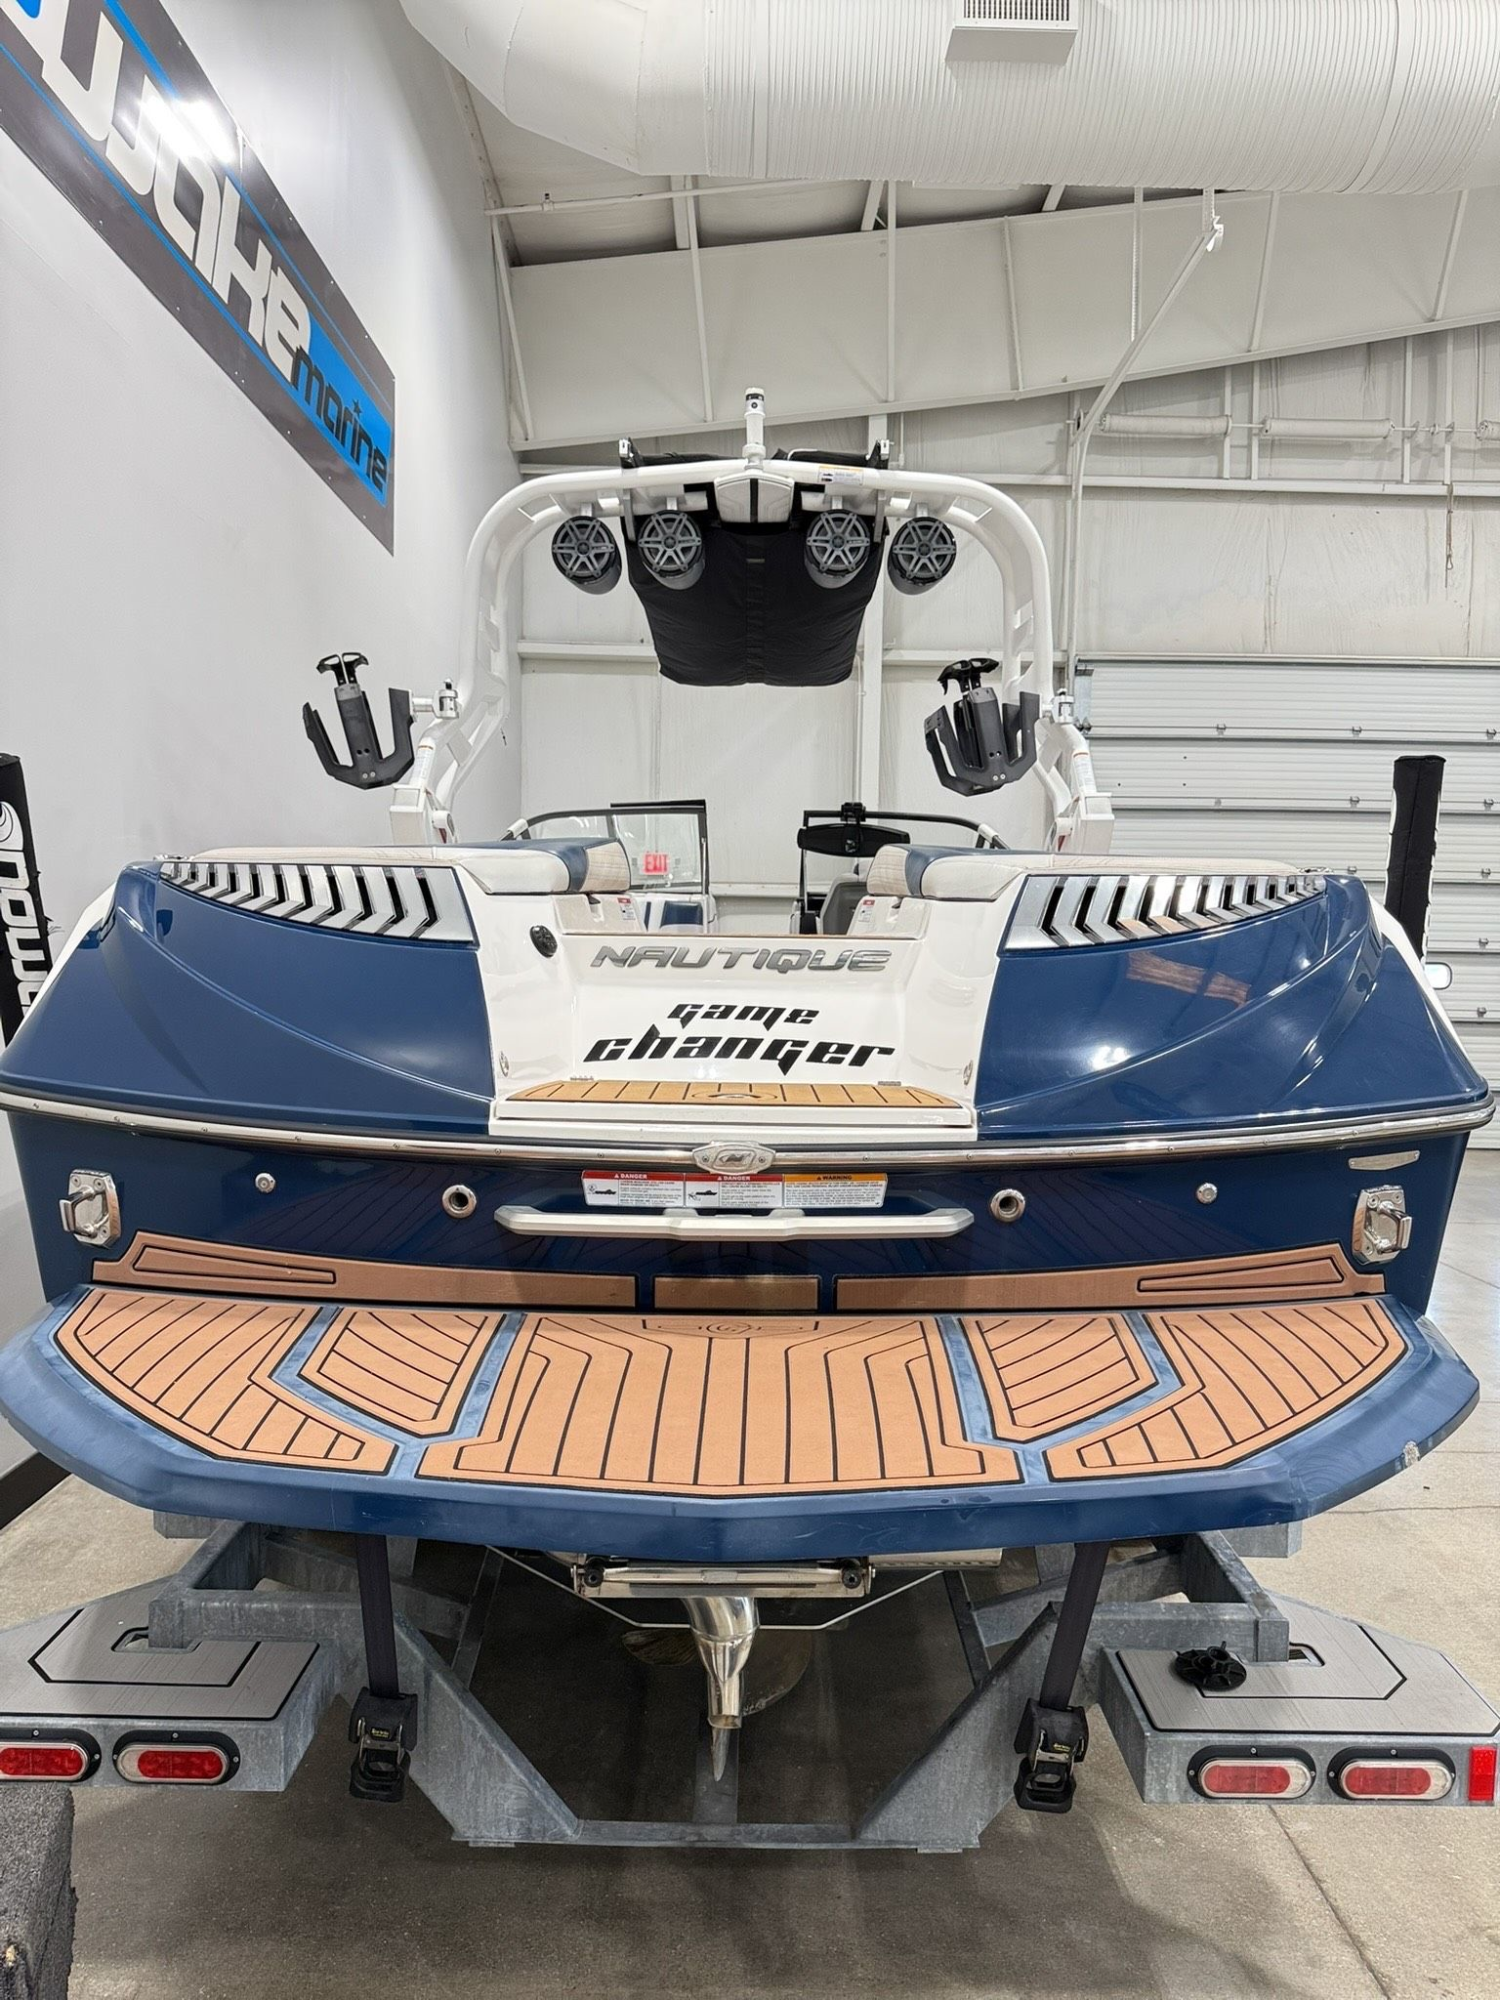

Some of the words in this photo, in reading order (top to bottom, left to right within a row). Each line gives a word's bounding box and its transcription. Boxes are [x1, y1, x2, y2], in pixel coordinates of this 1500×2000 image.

[290, 344, 389, 494] marine
[644, 854, 668, 873] EXIT
[590, 945, 892, 974] NAUTIQUE
[667, 1003, 820, 1032] game
[583, 1023, 896, 1077] changer
